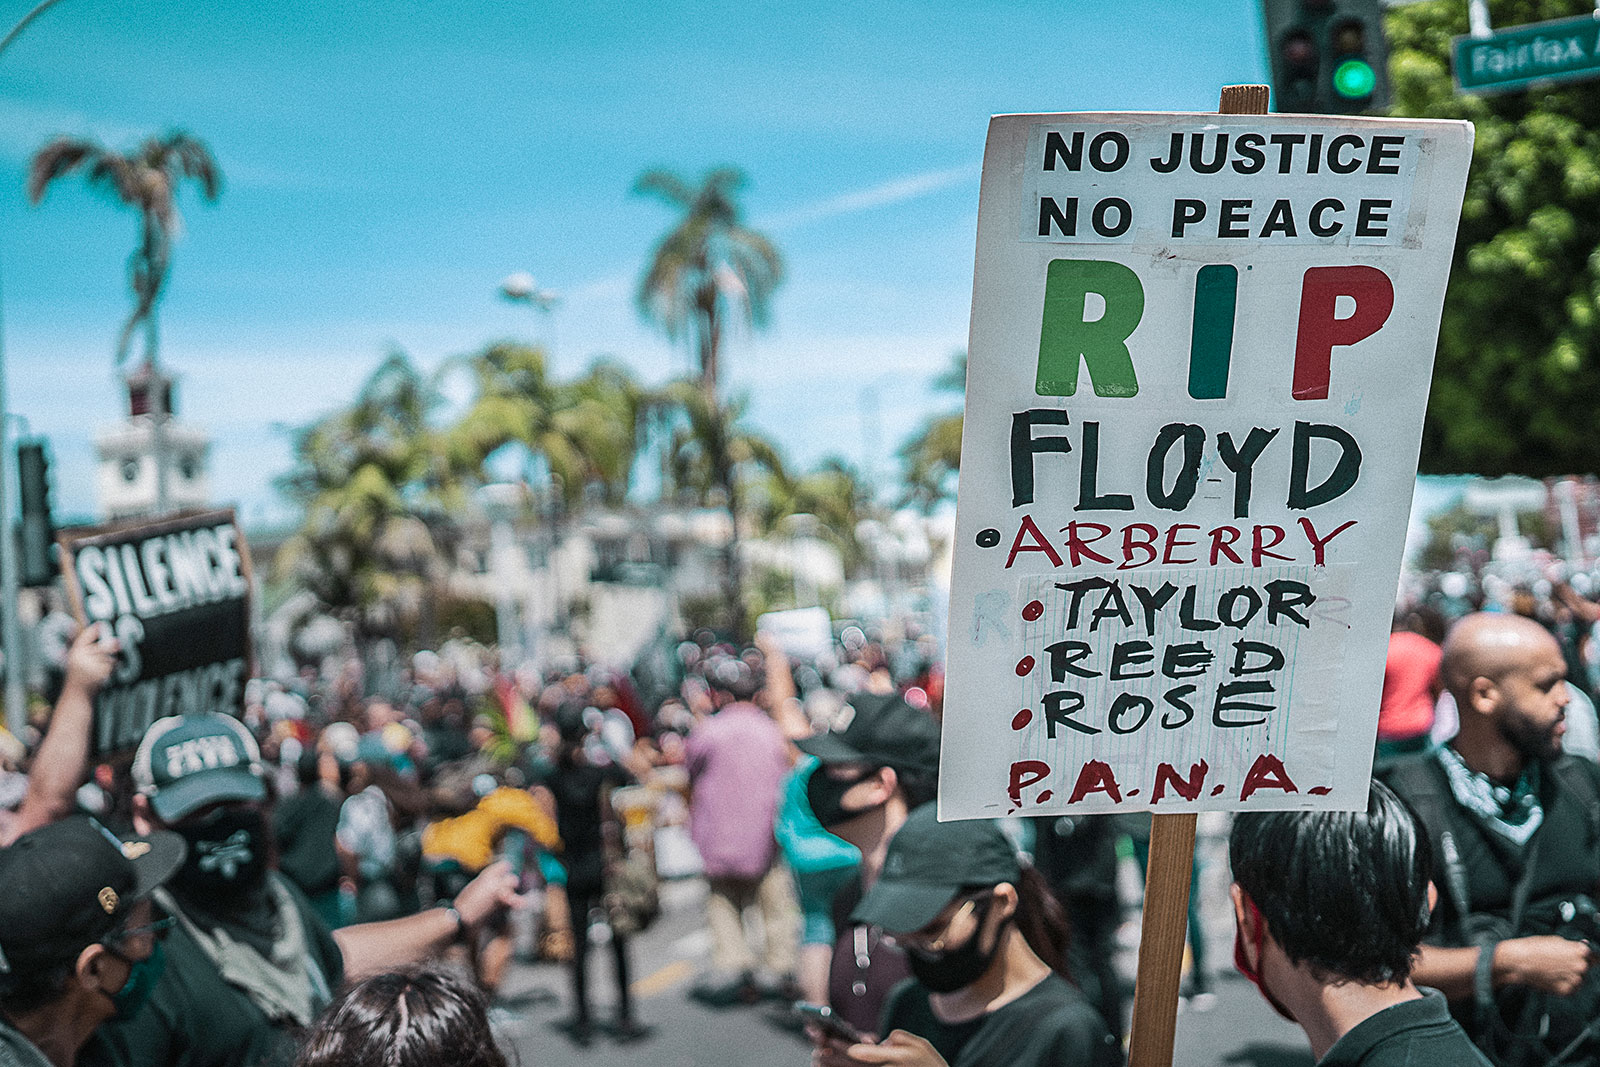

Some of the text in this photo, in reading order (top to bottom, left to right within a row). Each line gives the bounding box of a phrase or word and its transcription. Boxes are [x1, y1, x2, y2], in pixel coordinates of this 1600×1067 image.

[1472, 36, 1584, 72] Fairfax
[1043, 131, 1405, 174] NO JUSTICE
[1038, 197, 1393, 238] NO PEACE
[1035, 258, 1394, 400] RIP
[1010, 409, 1363, 518] FLOYD
[77, 525, 245, 619] SILENCE
[1054, 578, 1317, 636] TAYLOR
[1044, 638, 1286, 683] REED
[1040, 681, 1278, 739] ROSE
